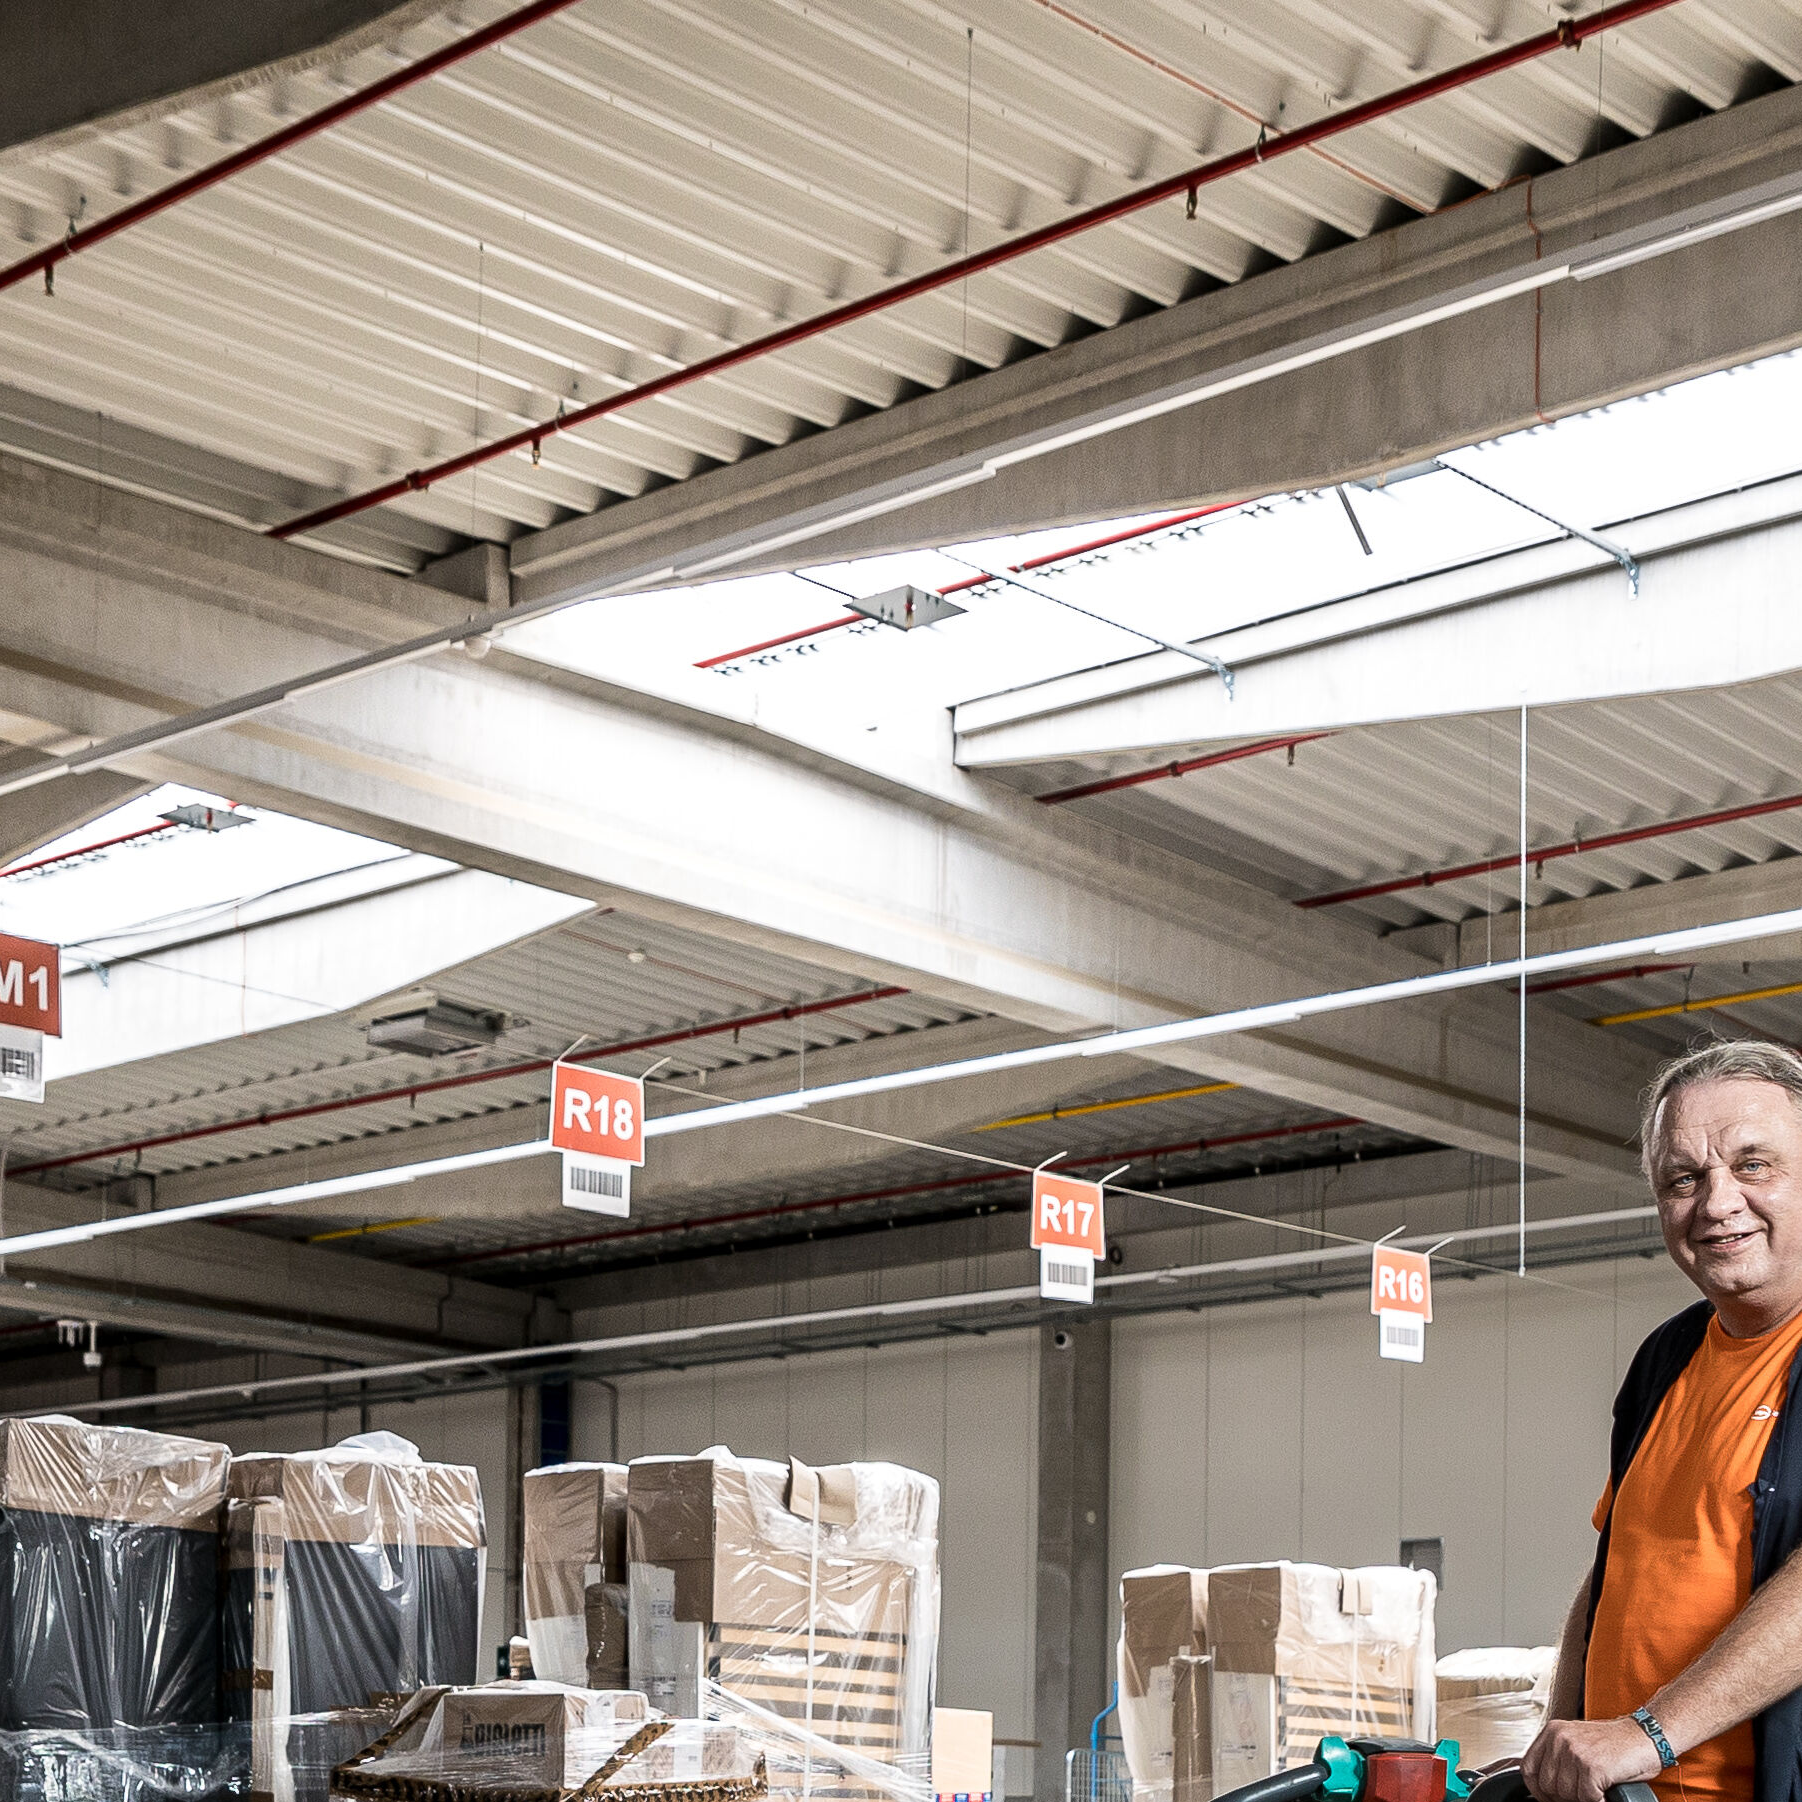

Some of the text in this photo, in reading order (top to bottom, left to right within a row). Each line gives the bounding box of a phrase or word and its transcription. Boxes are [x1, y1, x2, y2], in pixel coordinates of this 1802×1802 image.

[562, 1087, 635, 1141] R18
[1039, 1193, 1096, 1240] R17
[1377, 1268, 1425, 1305] R16
